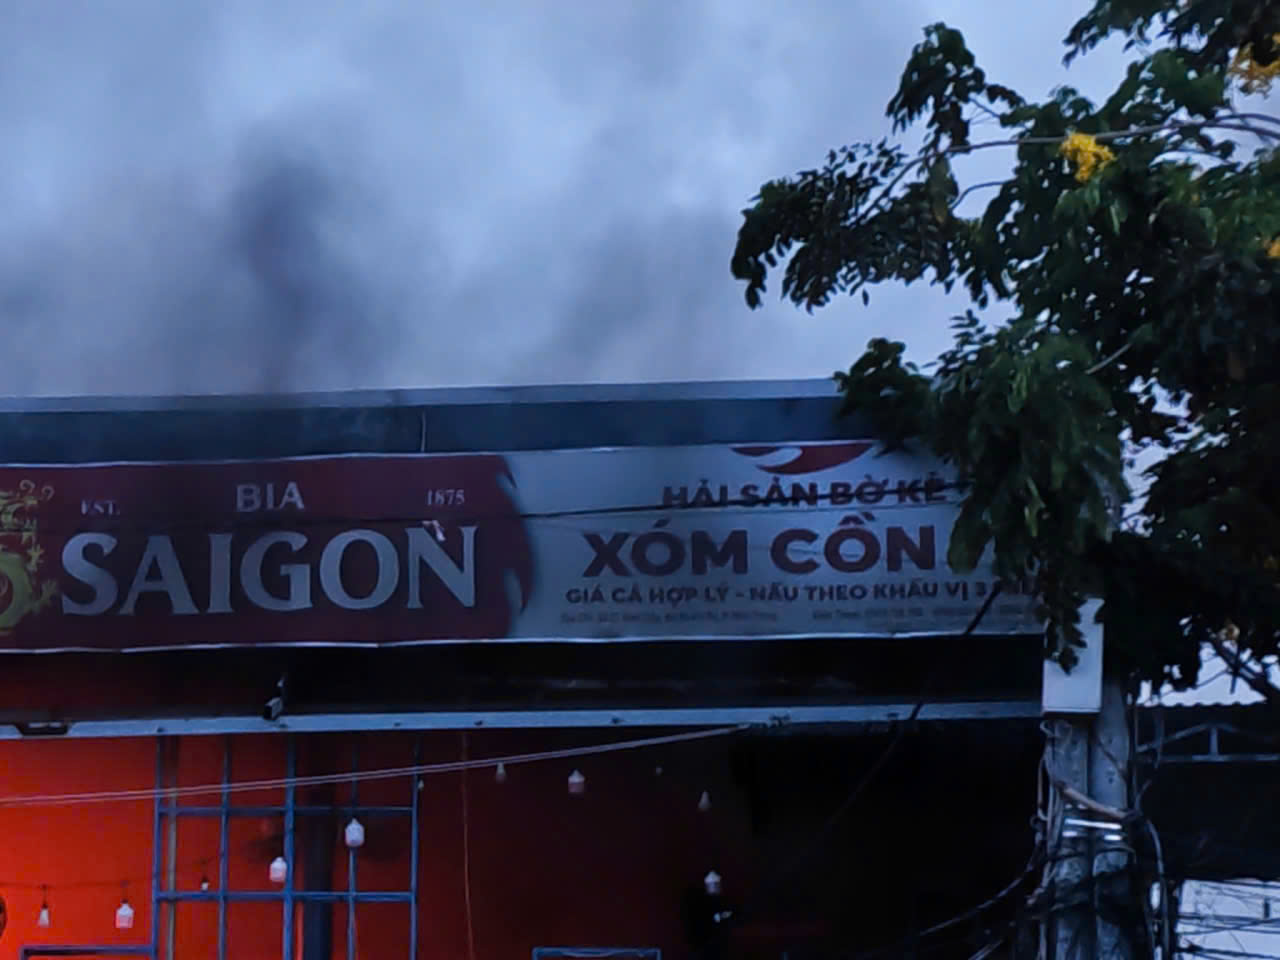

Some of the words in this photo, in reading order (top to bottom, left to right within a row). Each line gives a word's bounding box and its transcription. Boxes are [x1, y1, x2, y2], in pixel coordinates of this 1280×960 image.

[236, 482, 305, 513] BIA
[425, 488, 465, 506] 1875
[662, 478, 728, 507] HẢI
[740, 476, 818, 506] SẢN
[830, 474, 888, 504] BỜ
[581, 518, 748, 579] XÓM
[770, 511, 936, 574] CỒN
[61, 525, 478, 616] SAIGON
[566, 583, 606, 604] GIÁ
[803, 584, 867, 601] THEO
